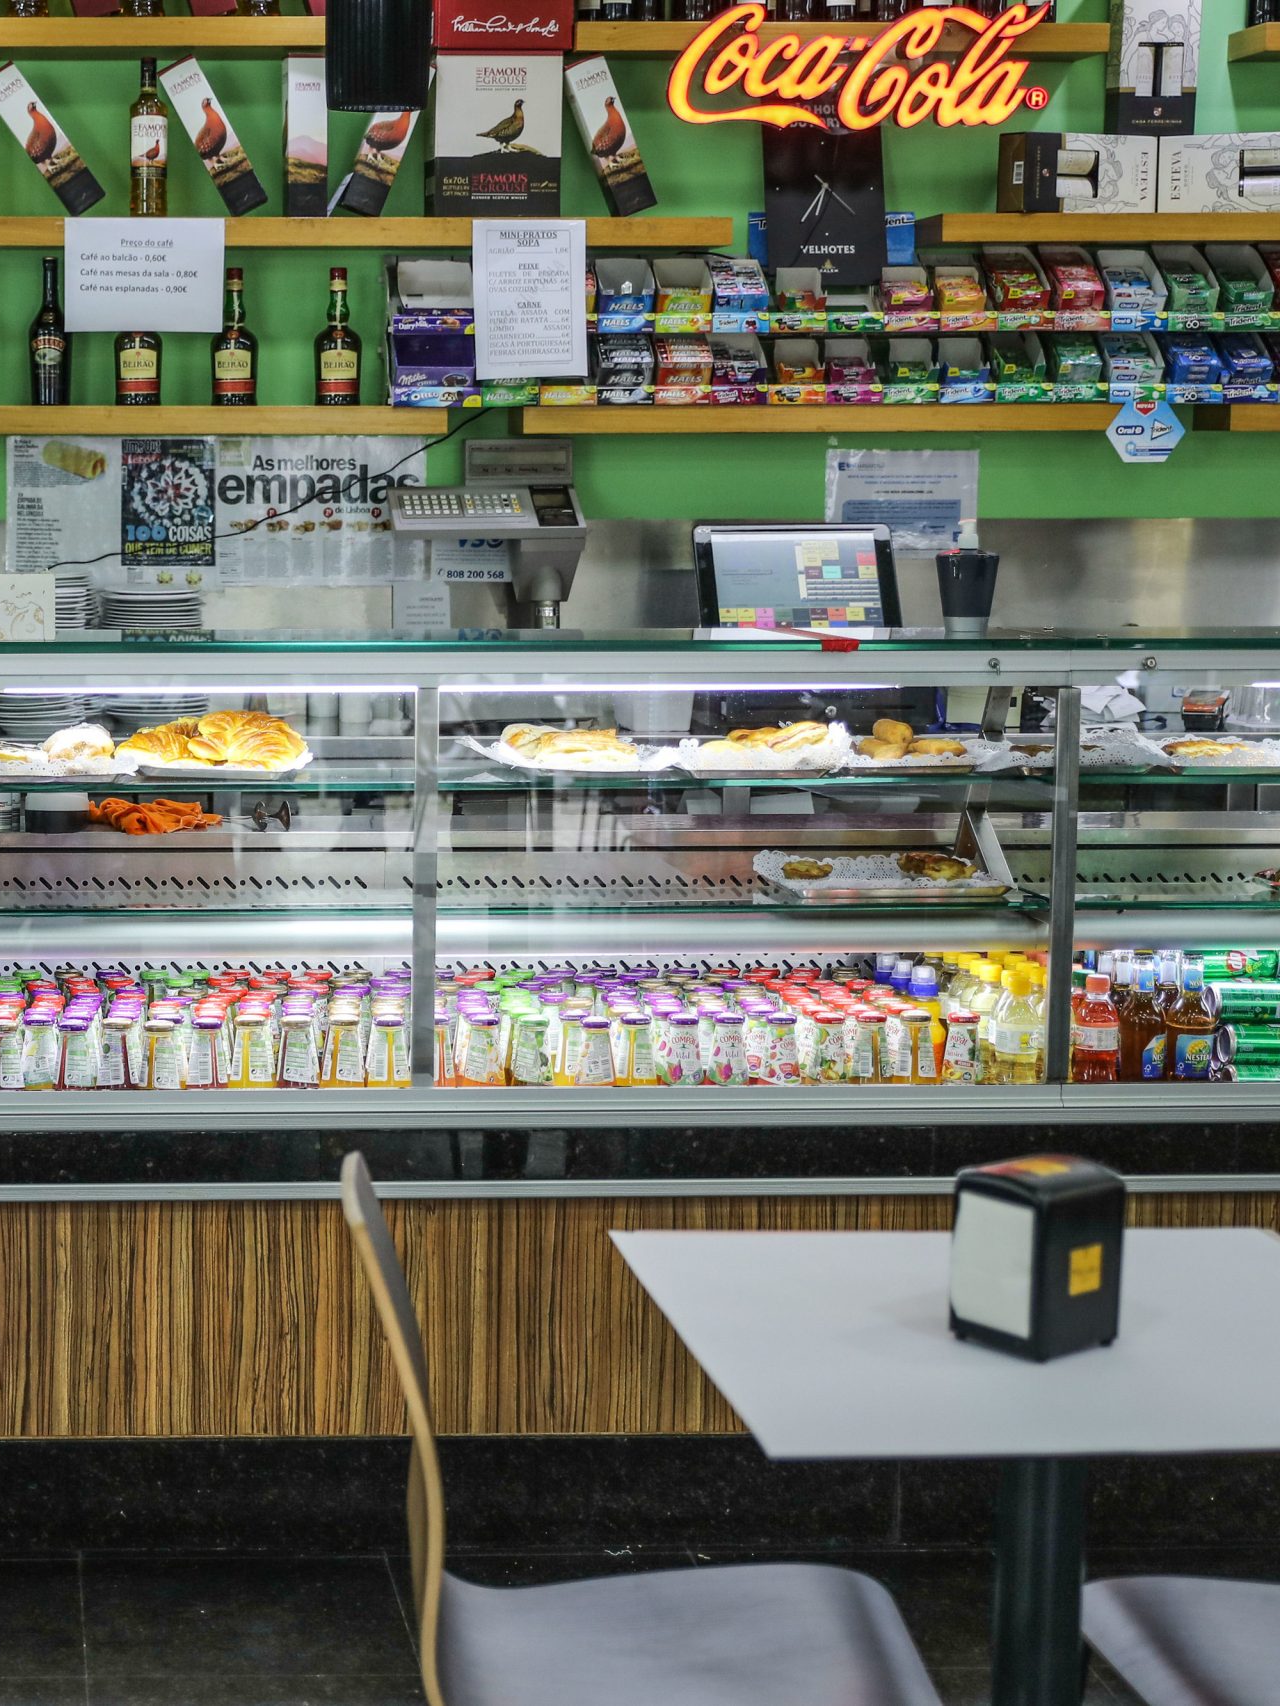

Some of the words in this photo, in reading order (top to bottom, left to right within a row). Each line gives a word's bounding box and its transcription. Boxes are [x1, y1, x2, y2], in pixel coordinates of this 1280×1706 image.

[667, 1, 1050, 130] Coca-Cola
[484, 67, 527, 76] FAMOUS
[483, 76, 527, 84] GROUSE
[480, 173, 528, 183] FAMOUS
[1140, 151, 1149, 200] ESTEVA
[1170, 151, 1182, 200] ESTEVA
[443, 176, 469, 185] 6x70cl
[480, 183, 528, 193] GROUSE
[500, 231, 558, 239] MINI-PRATOS
[120, 238, 143, 248] Preço
[145, 238, 155, 247] do
[157, 239, 174, 248] café
[517, 239, 540, 248] SOPA
[800, 245, 856, 255] VELHOTES
[80, 252, 98, 262] Café
[112, 253, 138, 262] balcão
[144, 254, 167, 263] 0,60€
[518, 263, 540, 271] PEIXE
[80, 268, 98, 277] Café
[142, 270, 152, 278] da
[154, 270, 169, 278] sala
[176, 270, 198, 279] 0,80€
[488, 270, 517, 278] FILETES
[79, 283, 97, 292] Café
[115, 285, 159, 294] esplanadas
[165, 286, 188, 294] 0,90€
[517, 301, 542, 309] CARNE
[609, 303, 645, 312] HALLS
[668, 303, 703, 312] HALLS
[602, 319, 630, 327] HALLS
[660, 318, 687, 326] HALLS
[888, 315, 913, 324] Trident
[945, 315, 970, 323] Trident
[1004, 314, 1027, 323] Trident
[1060, 314, 1085, 323] Trident
[1229, 315, 1259, 327] Trident
[398, 322, 417, 331] Dairy
[415, 320, 429, 328] Milk
[1185, 320, 1200, 329] 60
[122, 358, 154, 369] BEIRÃO
[217, 358, 249, 369] BEIRÃO
[323, 359, 355, 370] BEIRÃO
[398, 373, 427, 386] Milka
[609, 376, 645, 384] HALLS
[668, 376, 703, 384] HALLS
[601, 390, 630, 399] HALLS
[658, 390, 687, 399] HALLS
[887, 387, 913, 396] Trident
[944, 387, 970, 396] Trident
[1001, 387, 1026, 396] Trident
[1058, 387, 1083, 395] Trident
[411, 392, 439, 401] OREO
[486, 393, 514, 402] HALLS
[1183, 391, 1198, 401] 60
[1116, 426, 1143, 435] Oral-B
[1151, 424, 1173, 433] Trident
[252, 455, 275, 471] As
[277, 455, 357, 471] melhores
[335, 505, 345, 514] de
[346, 505, 371, 514] Lisboa
[126, 524, 167, 541] 100
[169, 525, 212, 542] COISAS
[125, 542, 143, 556] QUE
[145, 542, 165, 555] TEM
[166, 542, 177, 554] DE
[446, 570, 465, 579] 808
[467, 570, 485, 579] 200
[487, 570, 504, 580] 568
